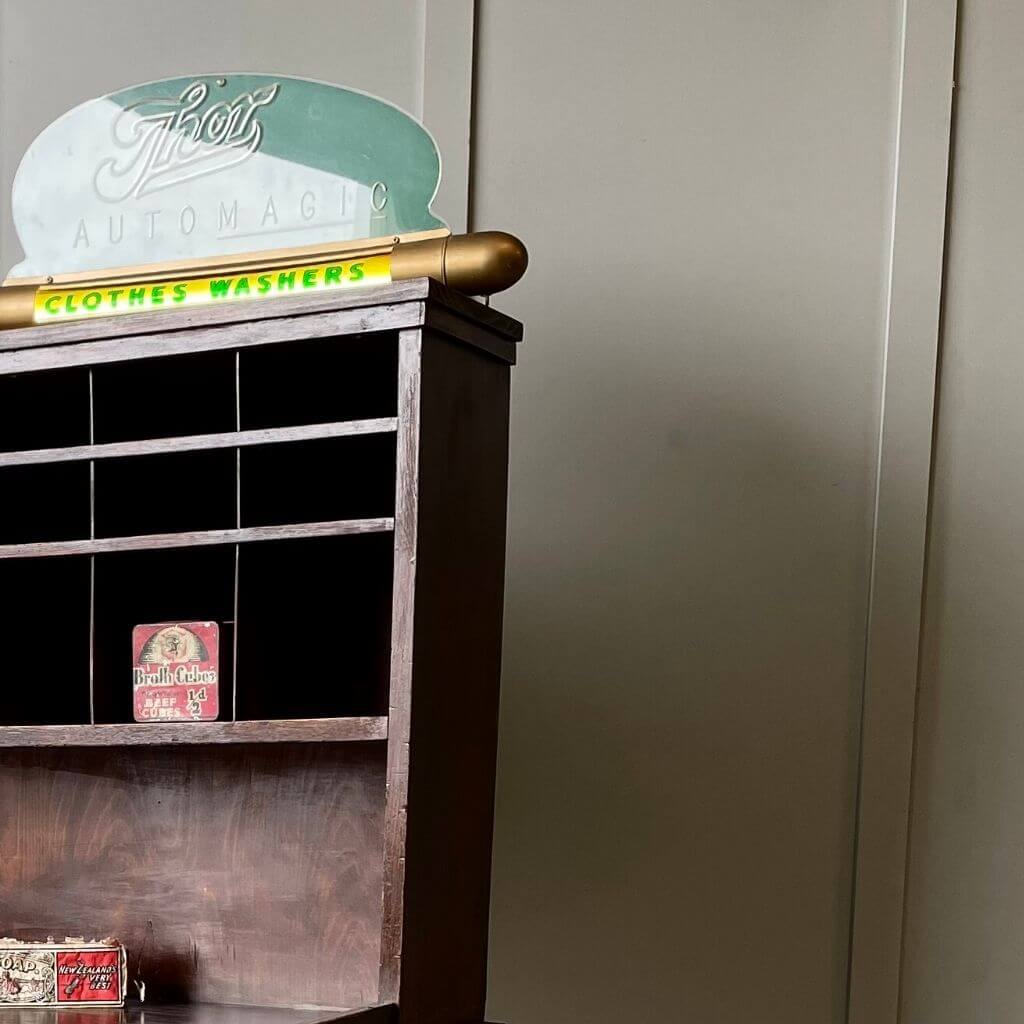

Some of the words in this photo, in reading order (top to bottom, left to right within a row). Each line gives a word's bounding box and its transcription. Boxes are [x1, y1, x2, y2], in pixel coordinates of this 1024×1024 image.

[72, 181, 388, 249] AUTOMAGIC
[44, 283, 188, 316] CLOTHES
[209, 262, 366, 299] WASHERS
[134, 666, 173, 686] Broth
[175, 664, 216, 685] Cubes
[89, 982, 112, 990] BEST
